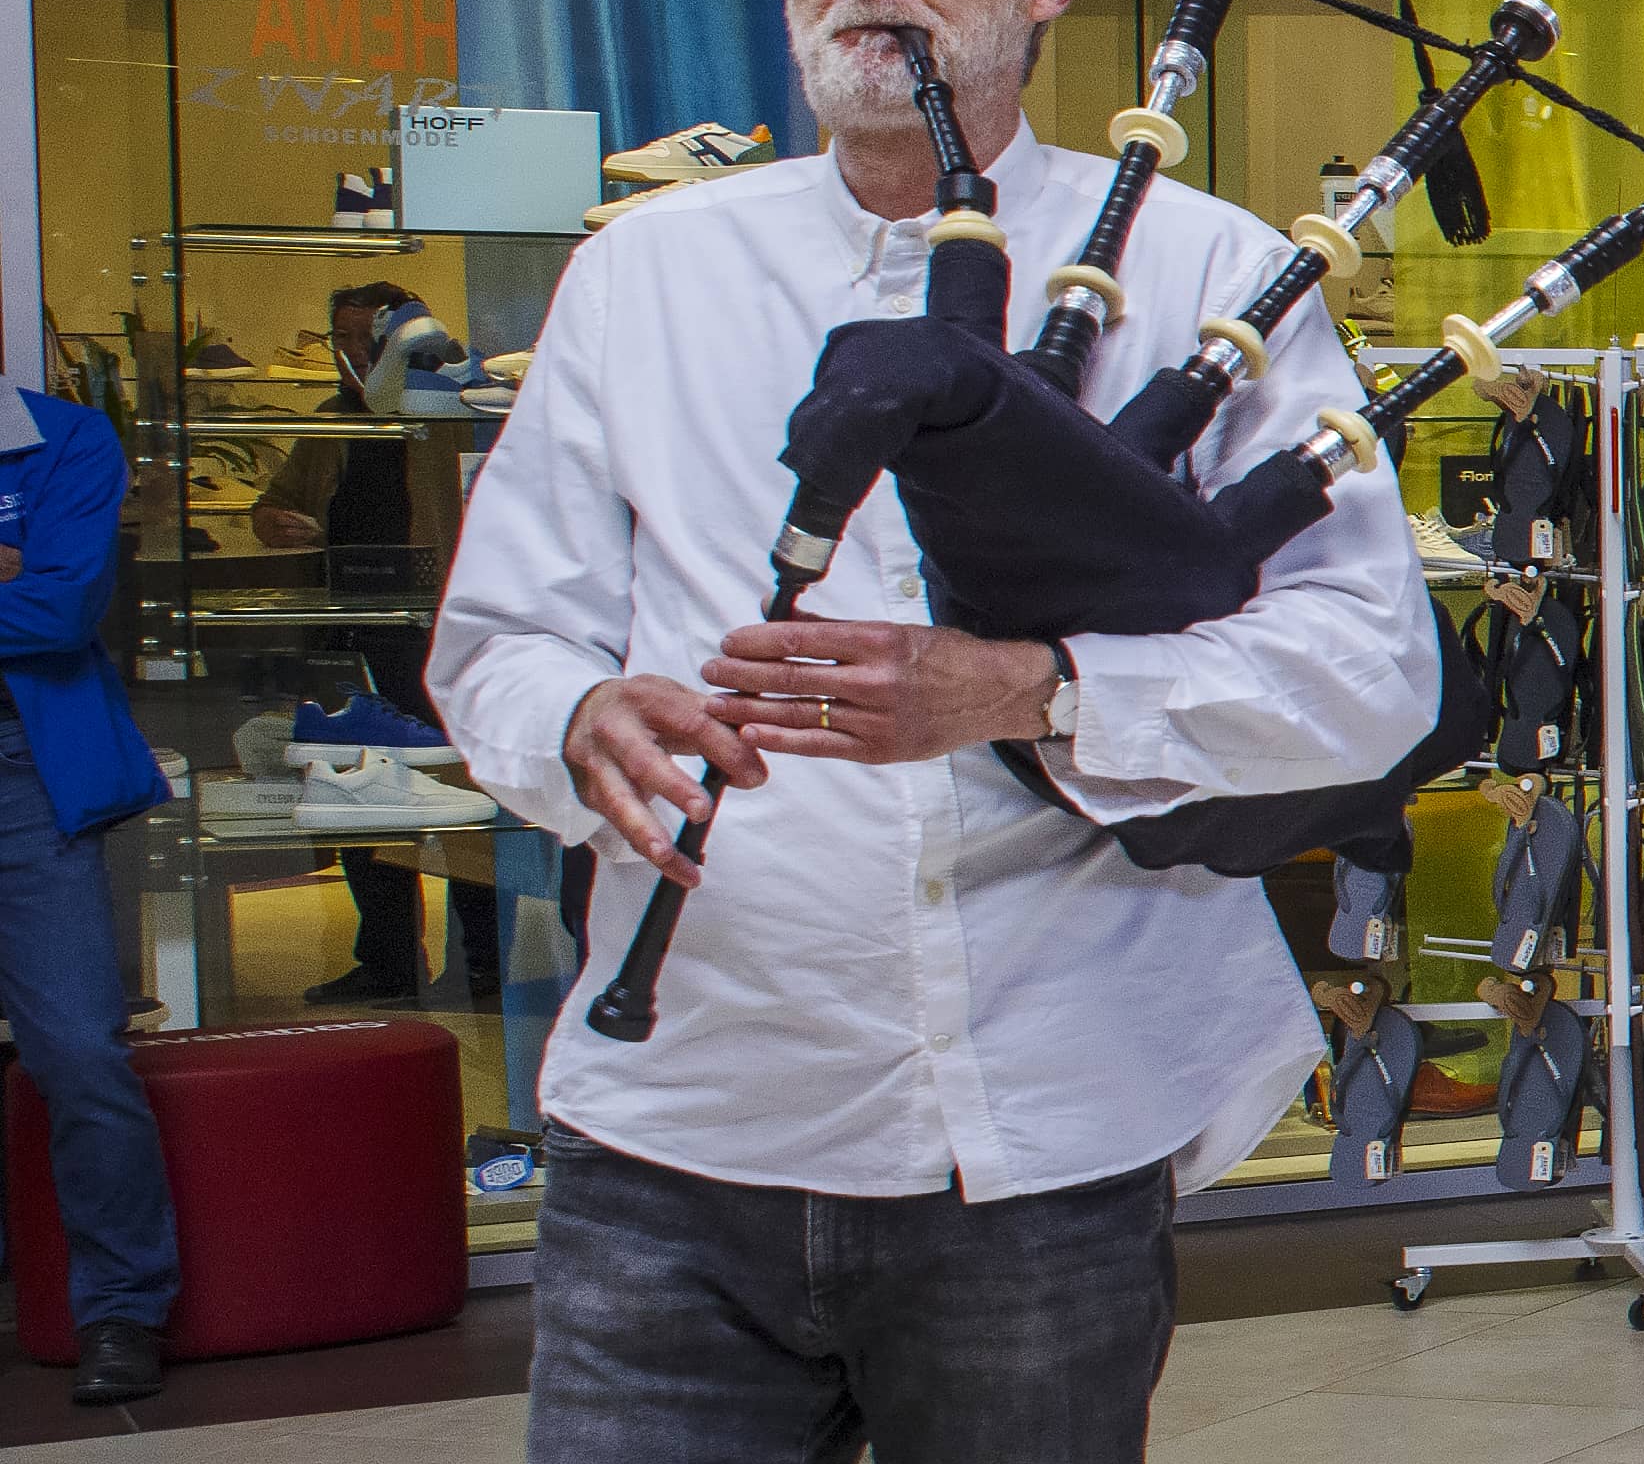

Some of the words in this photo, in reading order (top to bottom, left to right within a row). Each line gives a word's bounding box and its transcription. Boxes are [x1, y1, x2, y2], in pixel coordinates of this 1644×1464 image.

[411, 116, 485, 131] HOFF
[263, 126, 460, 147] SCHOENMODE
[130, 1019, 393, 1049] avaianas
